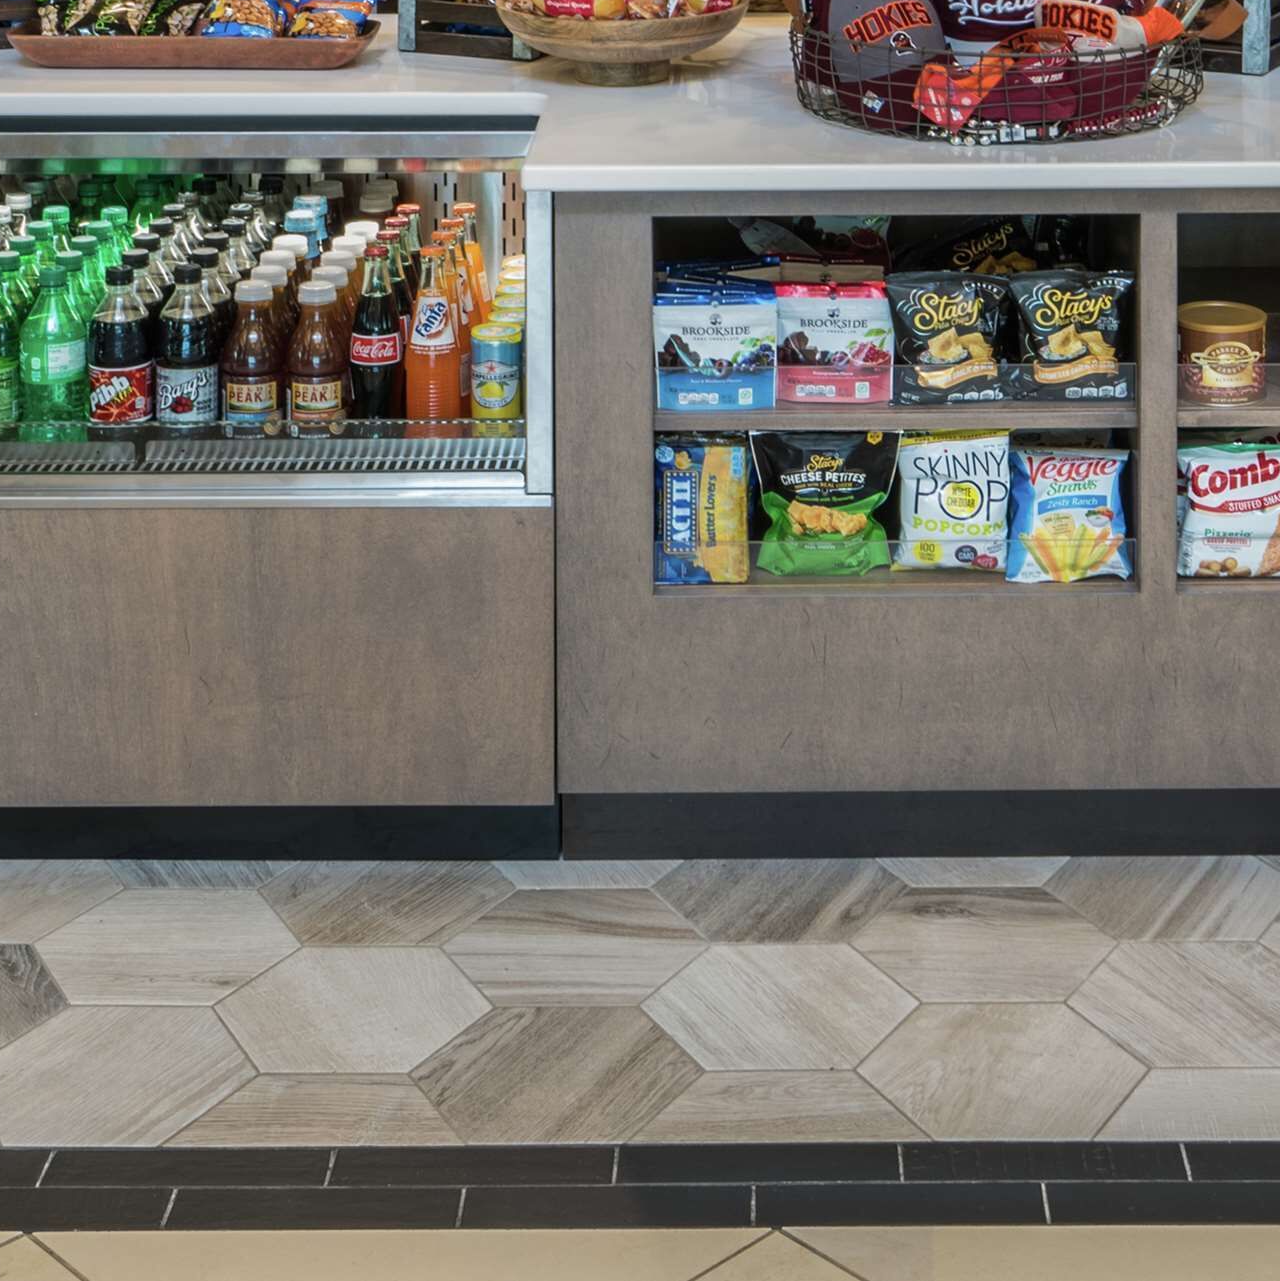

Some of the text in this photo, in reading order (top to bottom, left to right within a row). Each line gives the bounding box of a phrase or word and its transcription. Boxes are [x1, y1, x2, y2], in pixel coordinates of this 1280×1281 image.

[842, 0, 933, 54] HOKIES
[952, 223, 1014, 266] Stacy's
[1035, 289, 1113, 327] Stacy's
[415, 301, 447, 337] Fanta
[800, 318, 868, 329] BROOKSIDE
[682, 326, 751, 337] BROOKSIDE
[352, 340, 395, 358] Coca-Cola
[90, 375, 130, 411] Pibb
[160, 370, 208, 410] Barq's
[228, 391, 263, 402] PEAK
[294, 390, 328, 402] PEAK
[807, 454, 844, 472] Stacy's
[913, 448, 1006, 479] SKINNY
[1026, 455, 1117, 485] Veggie
[780, 471, 867, 486] CHEESE PETITES
[952, 484, 972, 498] WHITE
[1046, 480, 1098, 496] Straws
[913, 479, 1008, 521] POP
[946, 497, 975, 508] CHEDDAR
[1071, 497, 1098, 506] Ranch
[1228, 500, 1261, 512] STUFFED
[705, 475, 717, 547] Butter Lovers
[672, 504, 691, 546] ACT
[912, 516, 1004, 537] POPCORN
[1204, 528, 1252, 537] Pizzeria
[920, 543, 935, 553] 100
